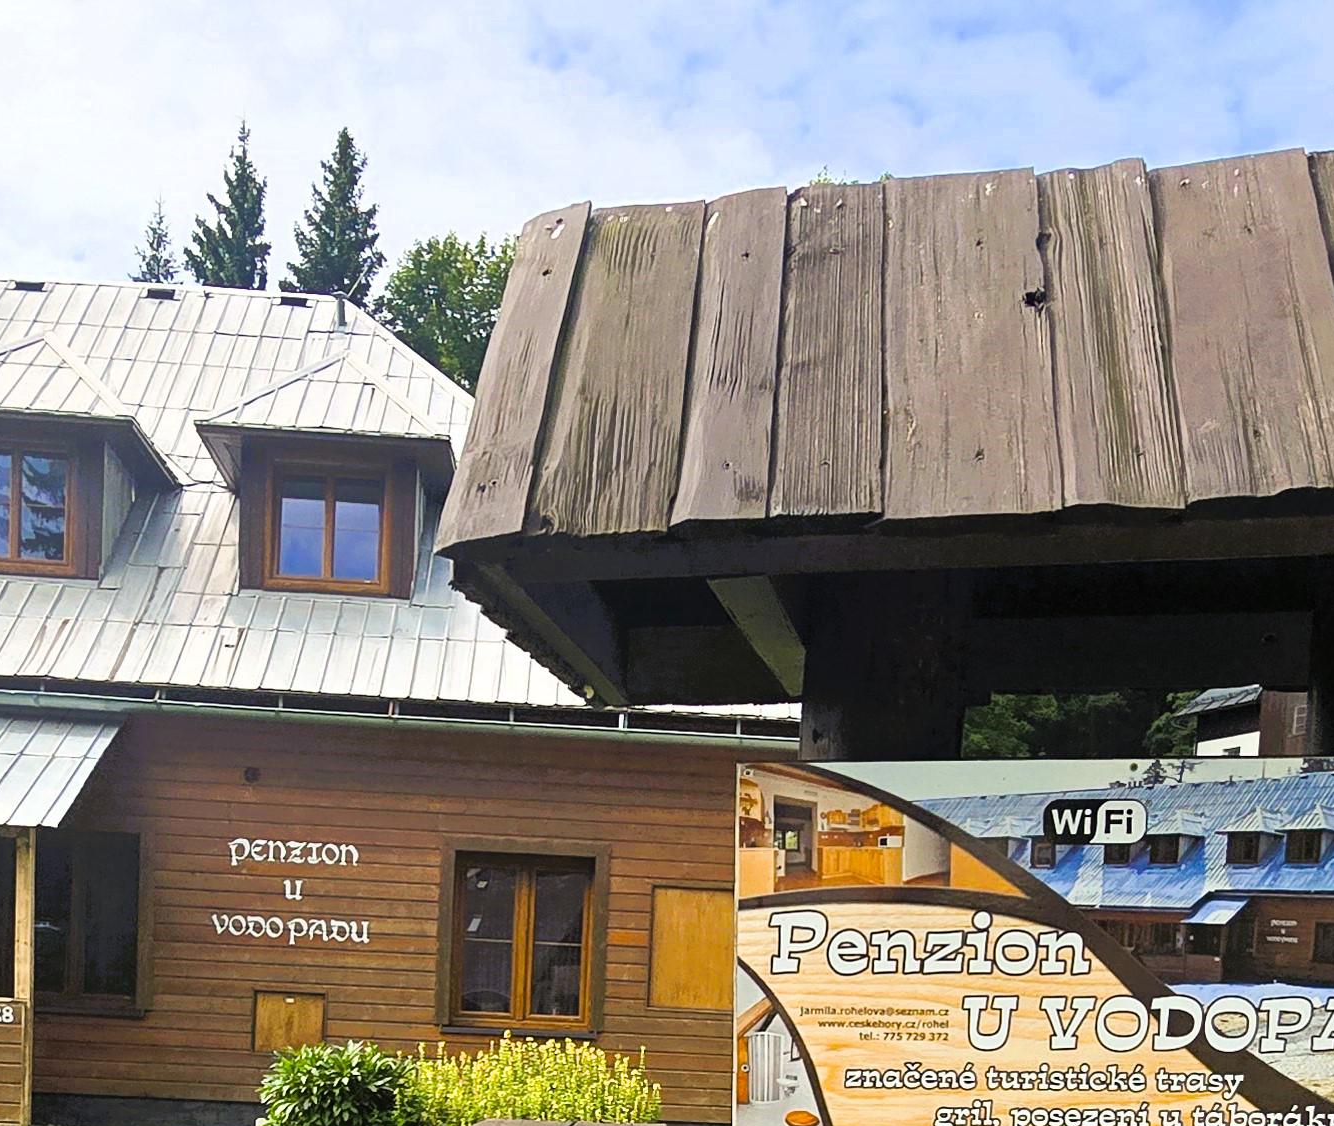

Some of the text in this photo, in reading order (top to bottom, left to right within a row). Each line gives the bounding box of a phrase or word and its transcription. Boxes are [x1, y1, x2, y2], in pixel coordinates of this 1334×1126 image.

[1051, 808, 1134, 835] WiFi
[227, 838, 359, 866] PENZION
[211, 914, 370, 945] VODOPADU
[769, 909, 1091, 976] Penzion
[817, 1019, 949, 1030] www.ceskehory.cz/rohel
[859, 1032, 949, 1041] tel.: 775 729 372
[962, 995, 1020, 1051] U
[844, 1062, 1244, 1100] značené turistické trasy
